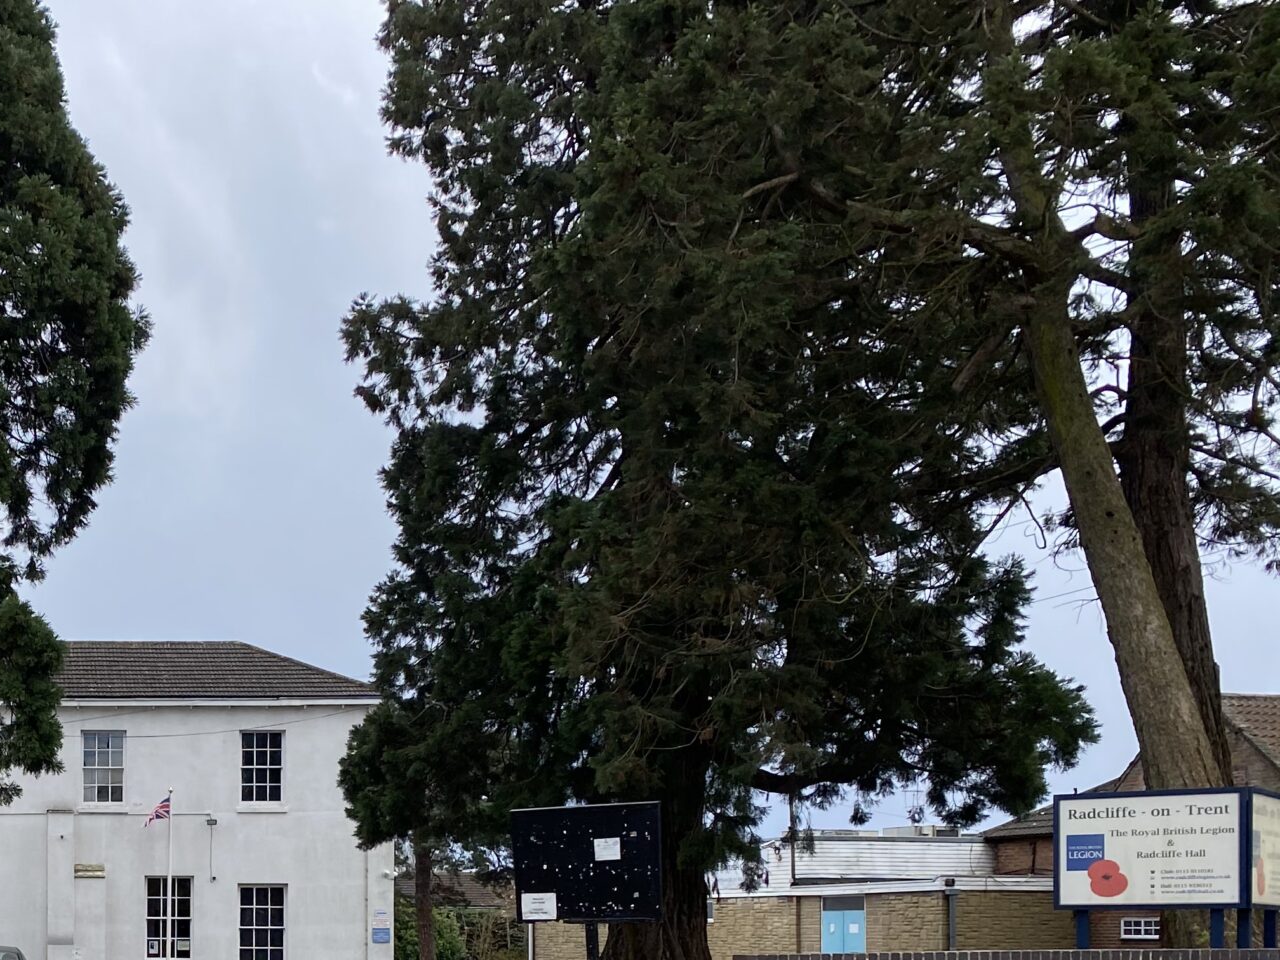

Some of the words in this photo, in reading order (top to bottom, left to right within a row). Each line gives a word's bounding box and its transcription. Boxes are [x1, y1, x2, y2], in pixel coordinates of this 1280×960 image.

[1068, 806, 1136, 820] Radcliffe
[1150, 807, 1171, 817] on
[1184, 804, 1229, 815] Trent
[1109, 829, 1128, 837] The
[1131, 828, 1160, 838] Royal
[1163, 826, 1197, 836] British
[1200, 825, 1235, 836] Legion
[1166, 839, 1175, 847] &
[1068, 850, 1103, 859] LEGION
[1136, 849, 1182, 859] Radcliffe
[1185, 849, 1206, 858] Hall
